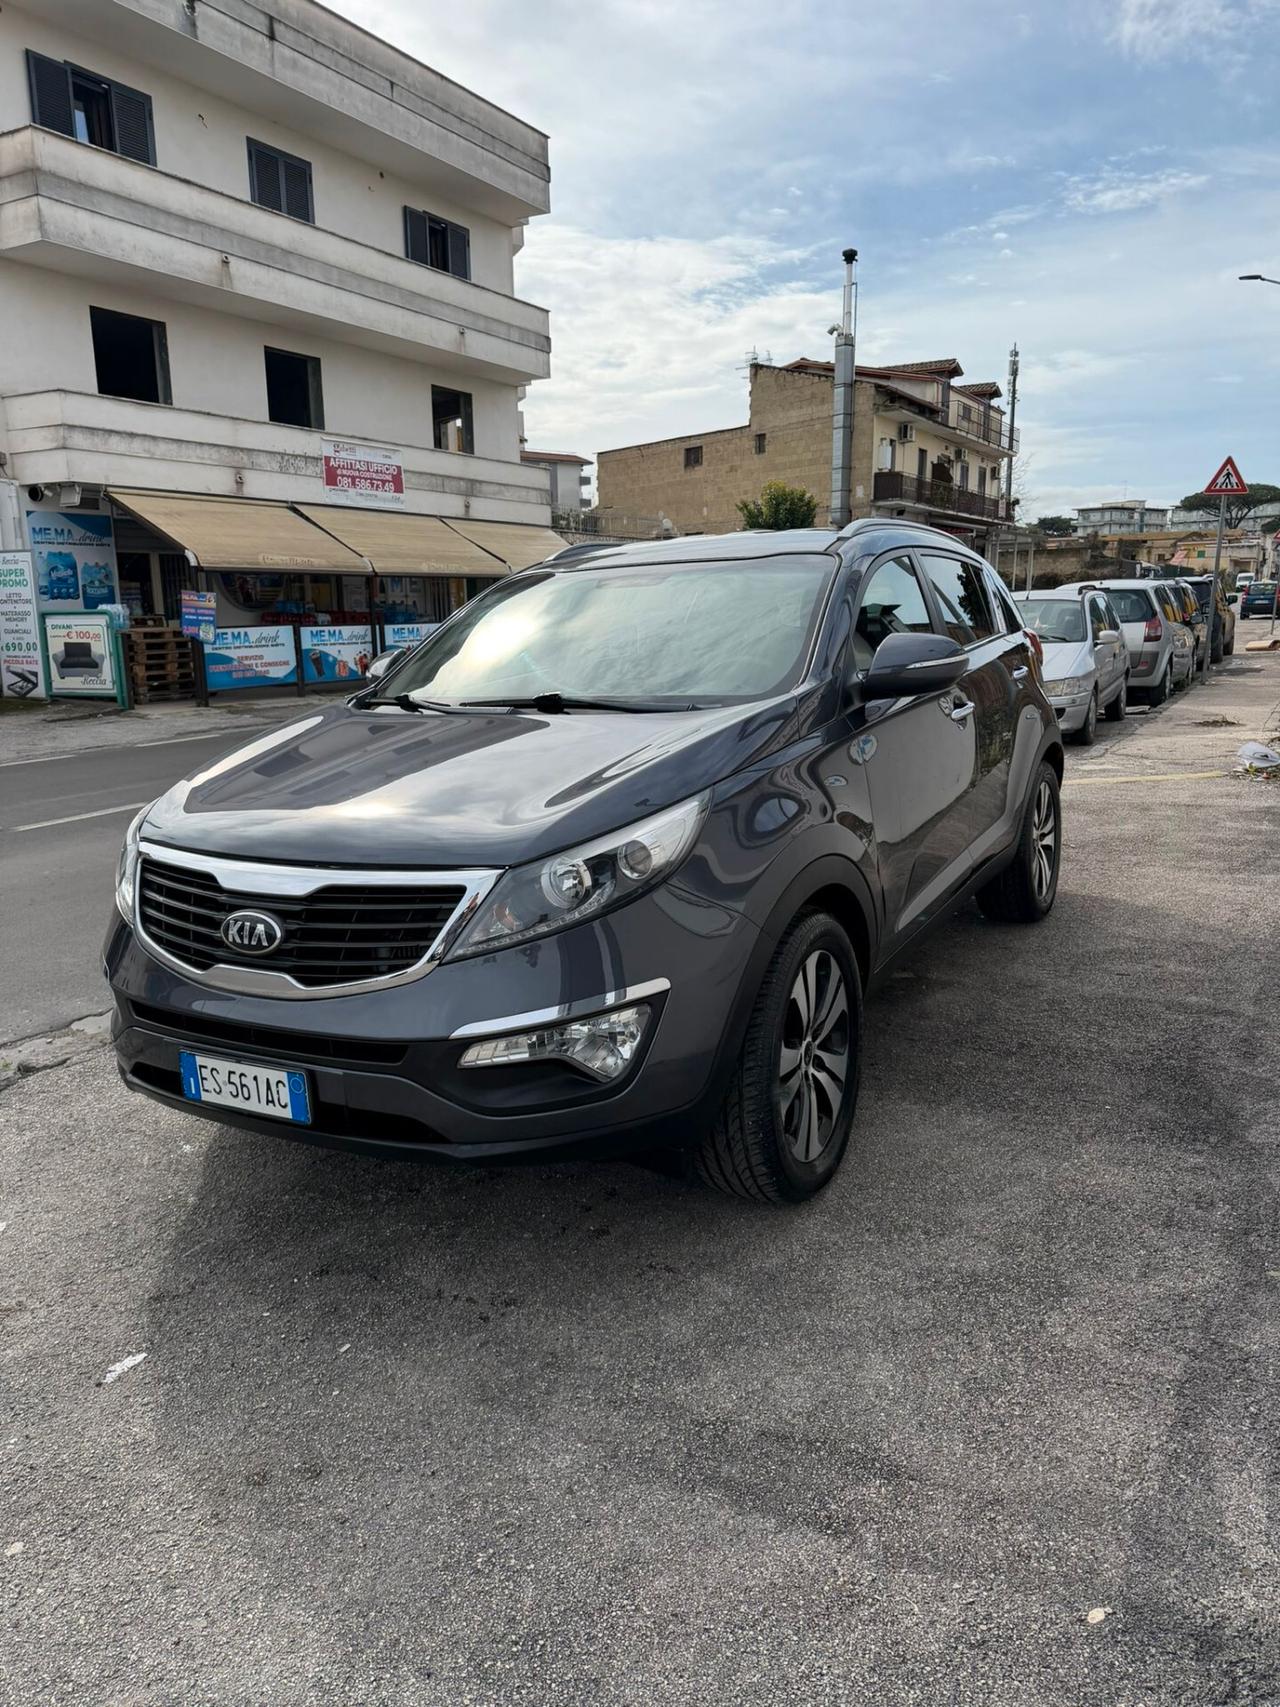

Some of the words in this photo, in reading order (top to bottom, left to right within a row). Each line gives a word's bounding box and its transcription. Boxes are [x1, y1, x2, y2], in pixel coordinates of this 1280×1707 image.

[329, 457, 367, 471] AFFITTASI
[369, 462, 398, 475] UFFICIO
[342, 469, 359, 477] NUOVA
[0, 578, 28, 588] ROMO
[227, 920, 269, 947] KIA
